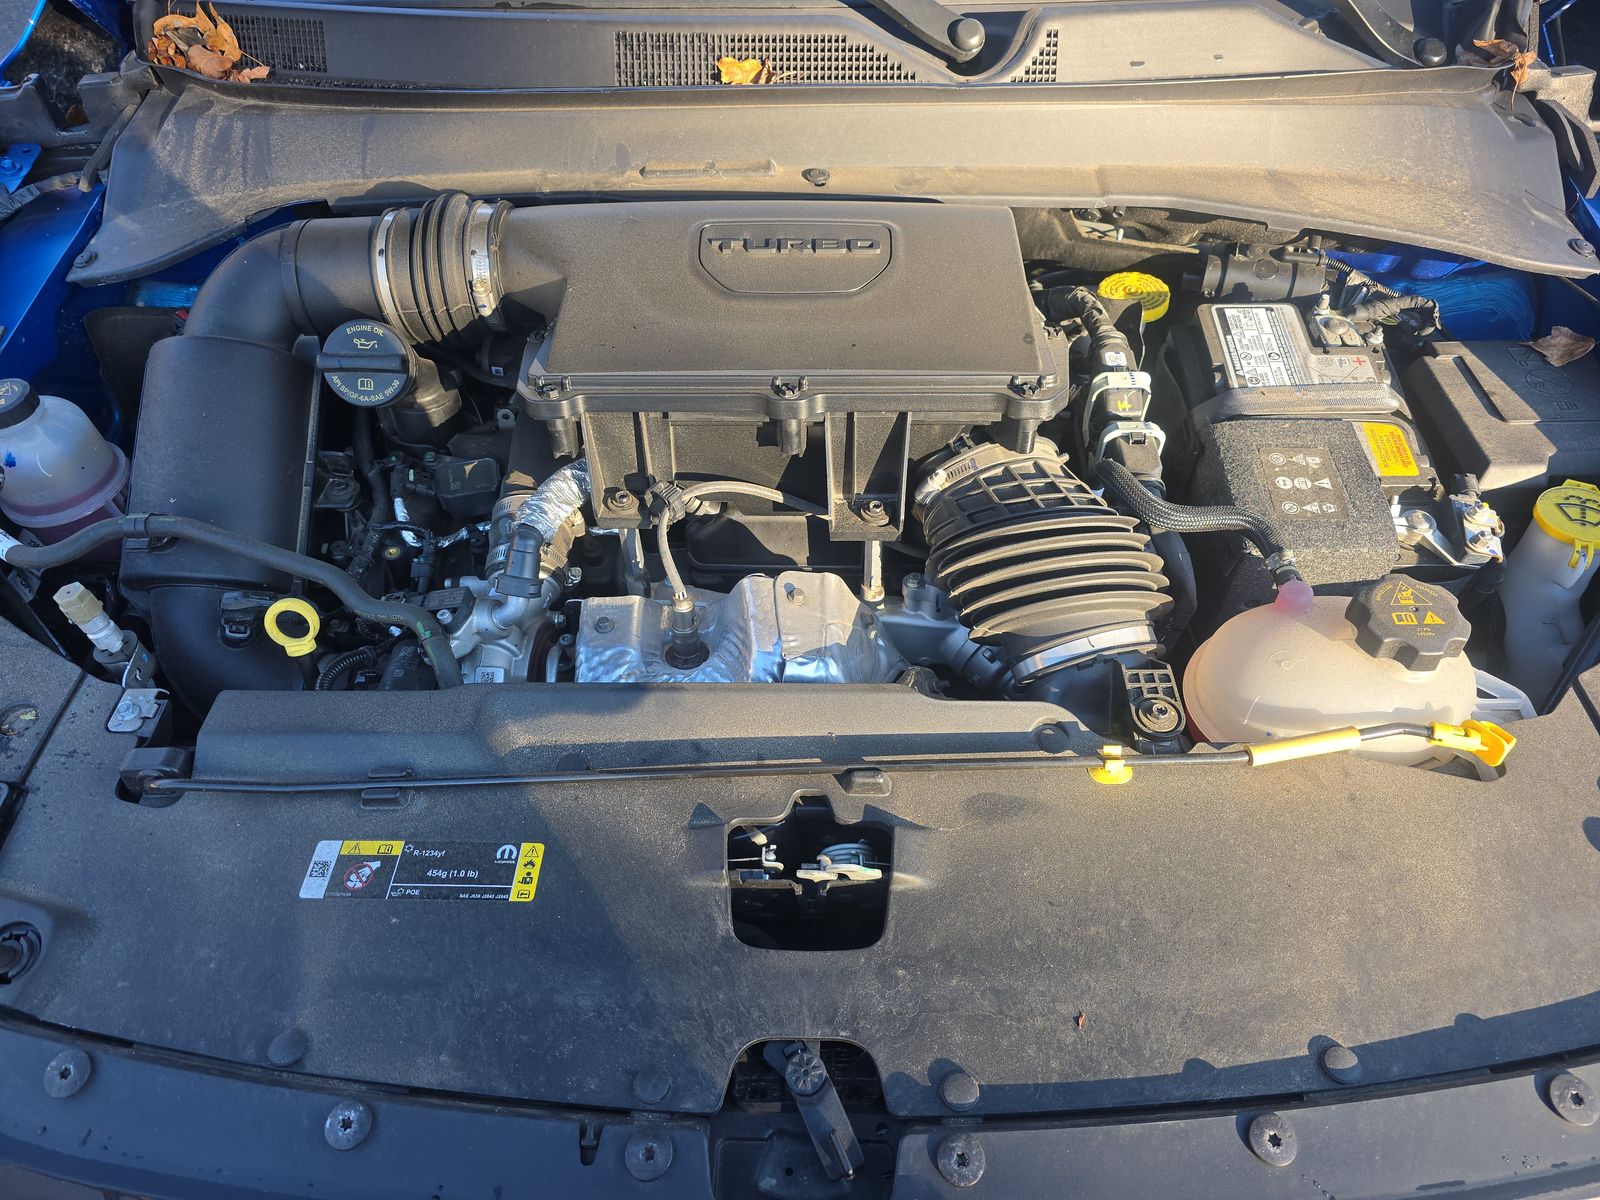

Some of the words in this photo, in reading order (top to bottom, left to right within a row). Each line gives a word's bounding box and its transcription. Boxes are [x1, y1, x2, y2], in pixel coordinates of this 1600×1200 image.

[707, 237, 881, 254] TURBO
[346, 325, 372, 335] ENGINE
[373, 327, 384, 336] OIL
[332, 375, 342, 387] API
[413, 849, 446, 858] R-1234yf
[427, 869, 448, 879] 454g
[449, 869, 466, 879] (1.0
[467, 870, 479, 879] lb)
